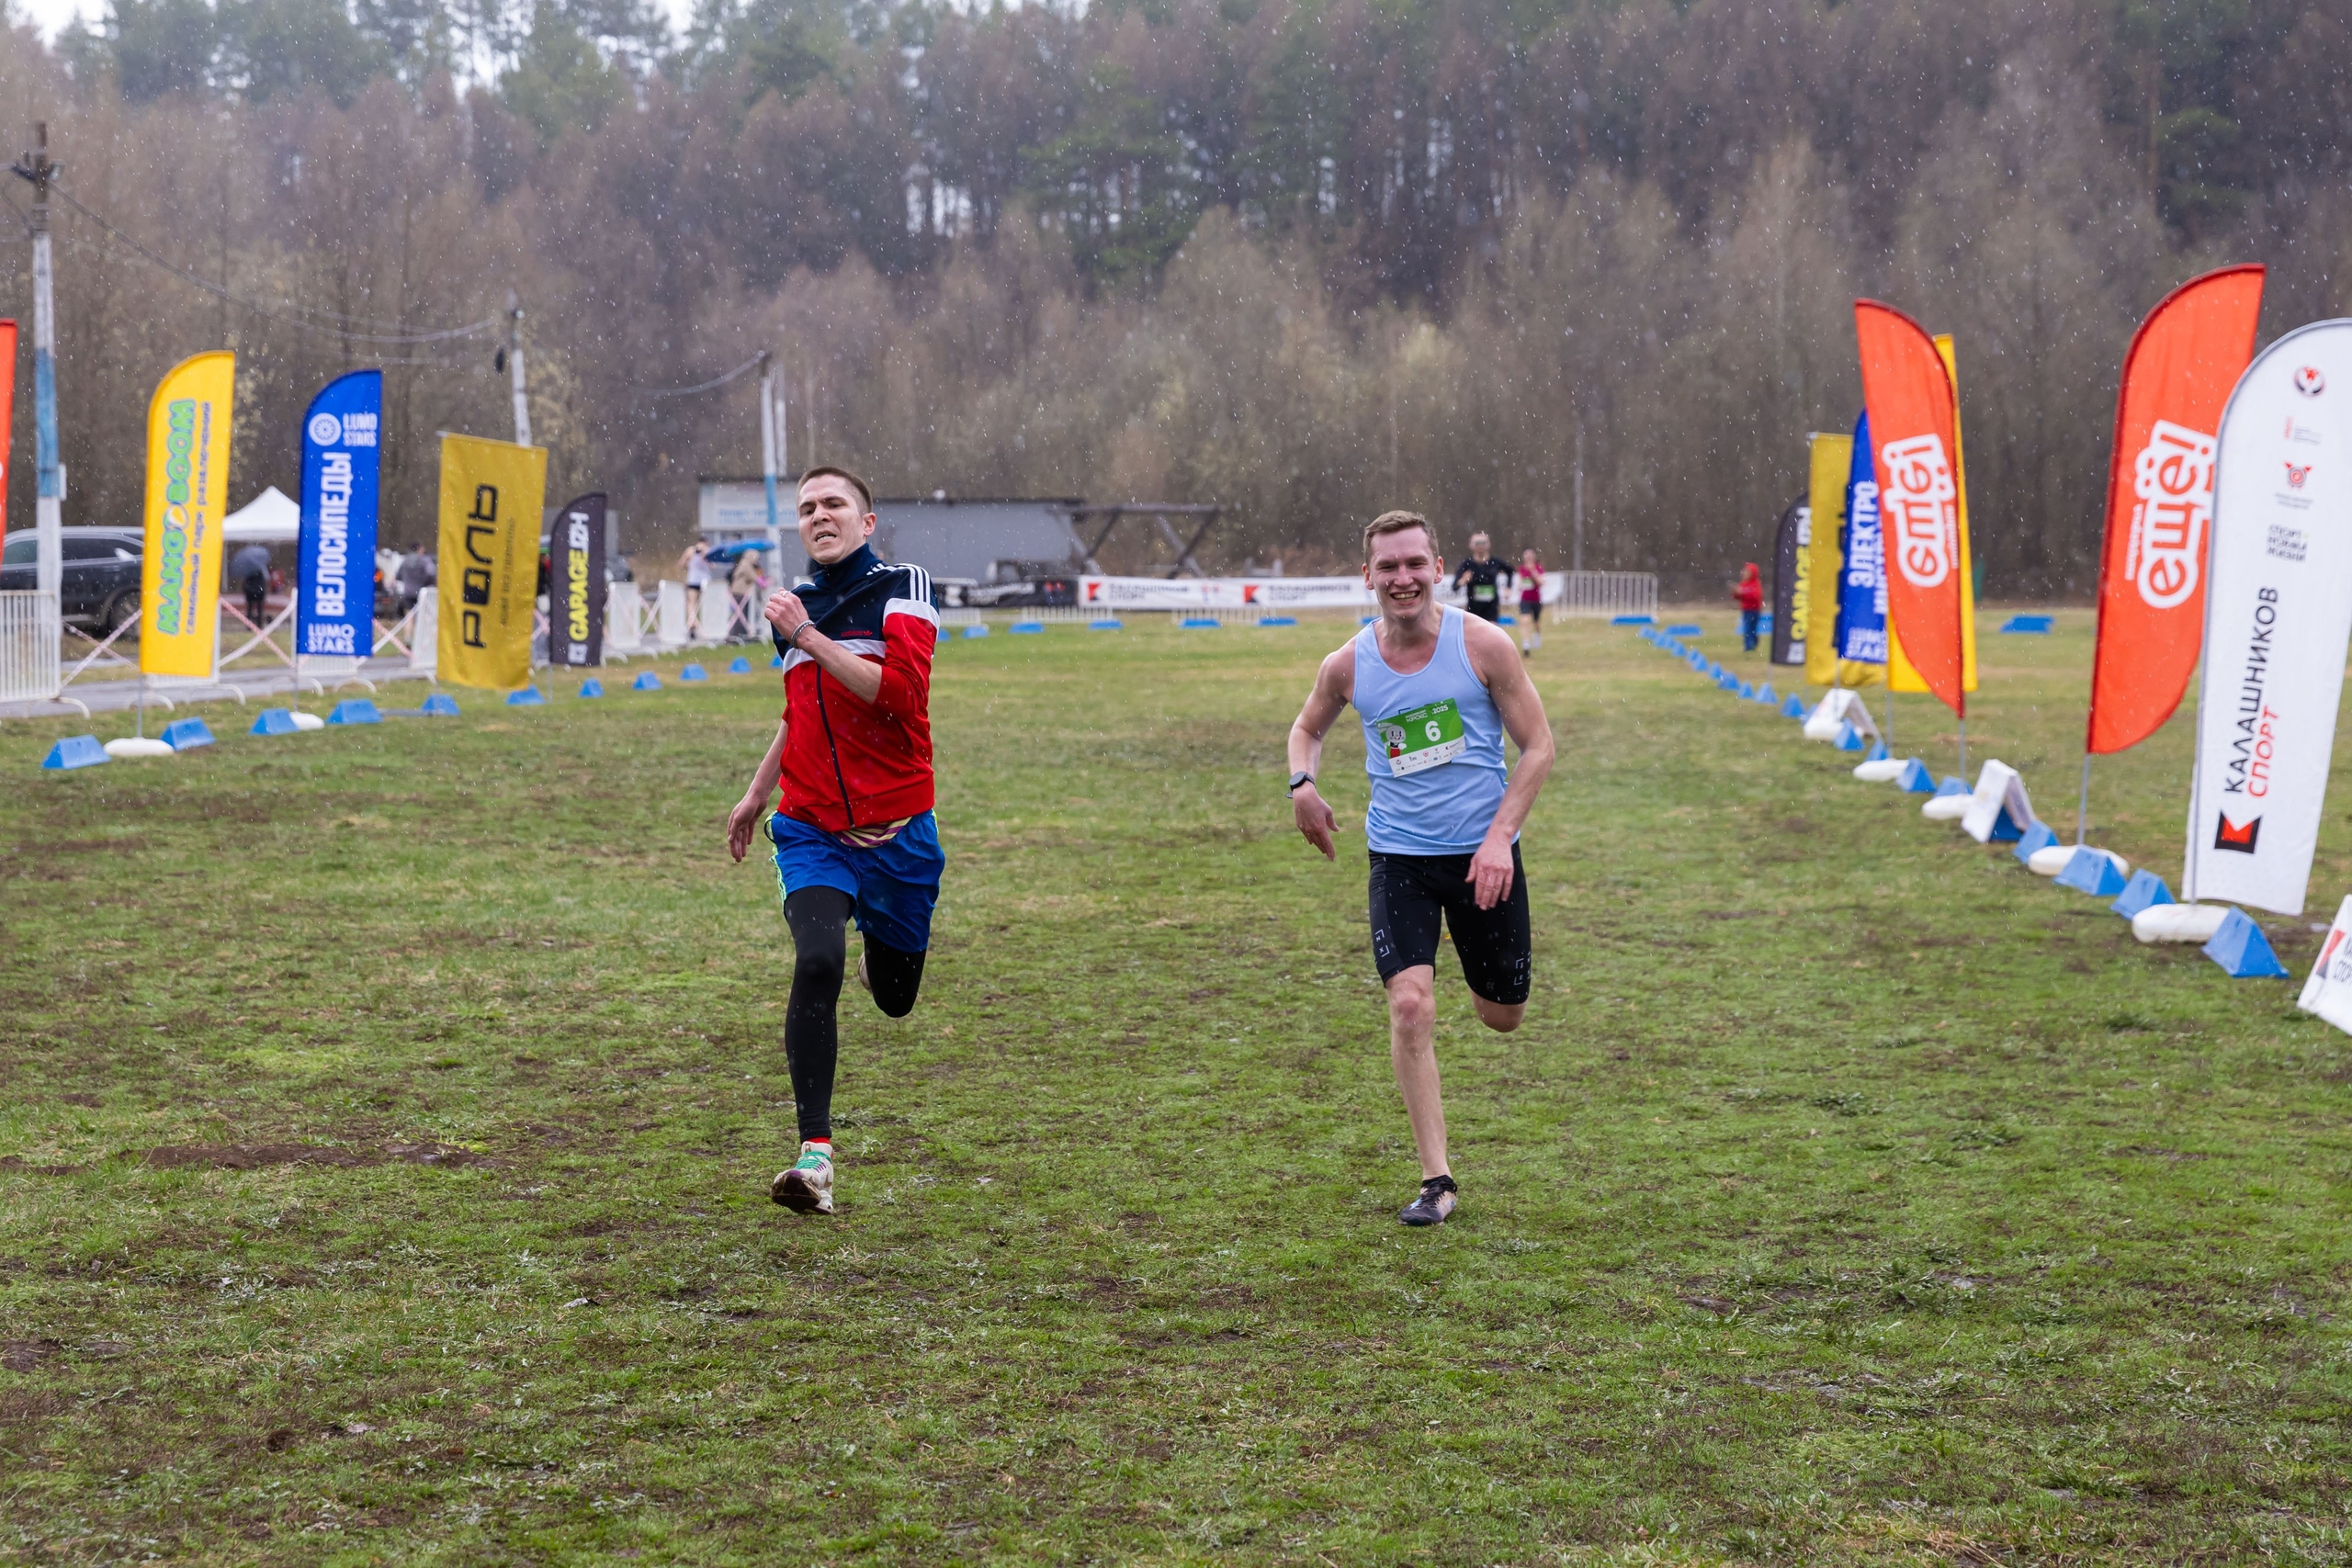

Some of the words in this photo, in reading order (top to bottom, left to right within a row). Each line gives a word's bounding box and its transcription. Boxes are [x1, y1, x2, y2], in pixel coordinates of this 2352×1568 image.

[343, 412, 378, 430] LUMO
[343, 431, 377, 447] STARS
[315, 452, 354, 616] ВЕЛОСИПЕДЫ
[1847, 480, 1879, 588] ЭЛЕКТРО
[2143, 426, 2212, 603] ещё!
[462, 483, 498, 649] РОЛЬ
[308, 623, 355, 638] LUMO
[308, 636, 355, 653] STARS
[1425, 720, 1442, 742] 6
[2224, 588, 2278, 793] КАЛАШНИКОВ
[2248, 705, 2278, 797] СПОРТ
